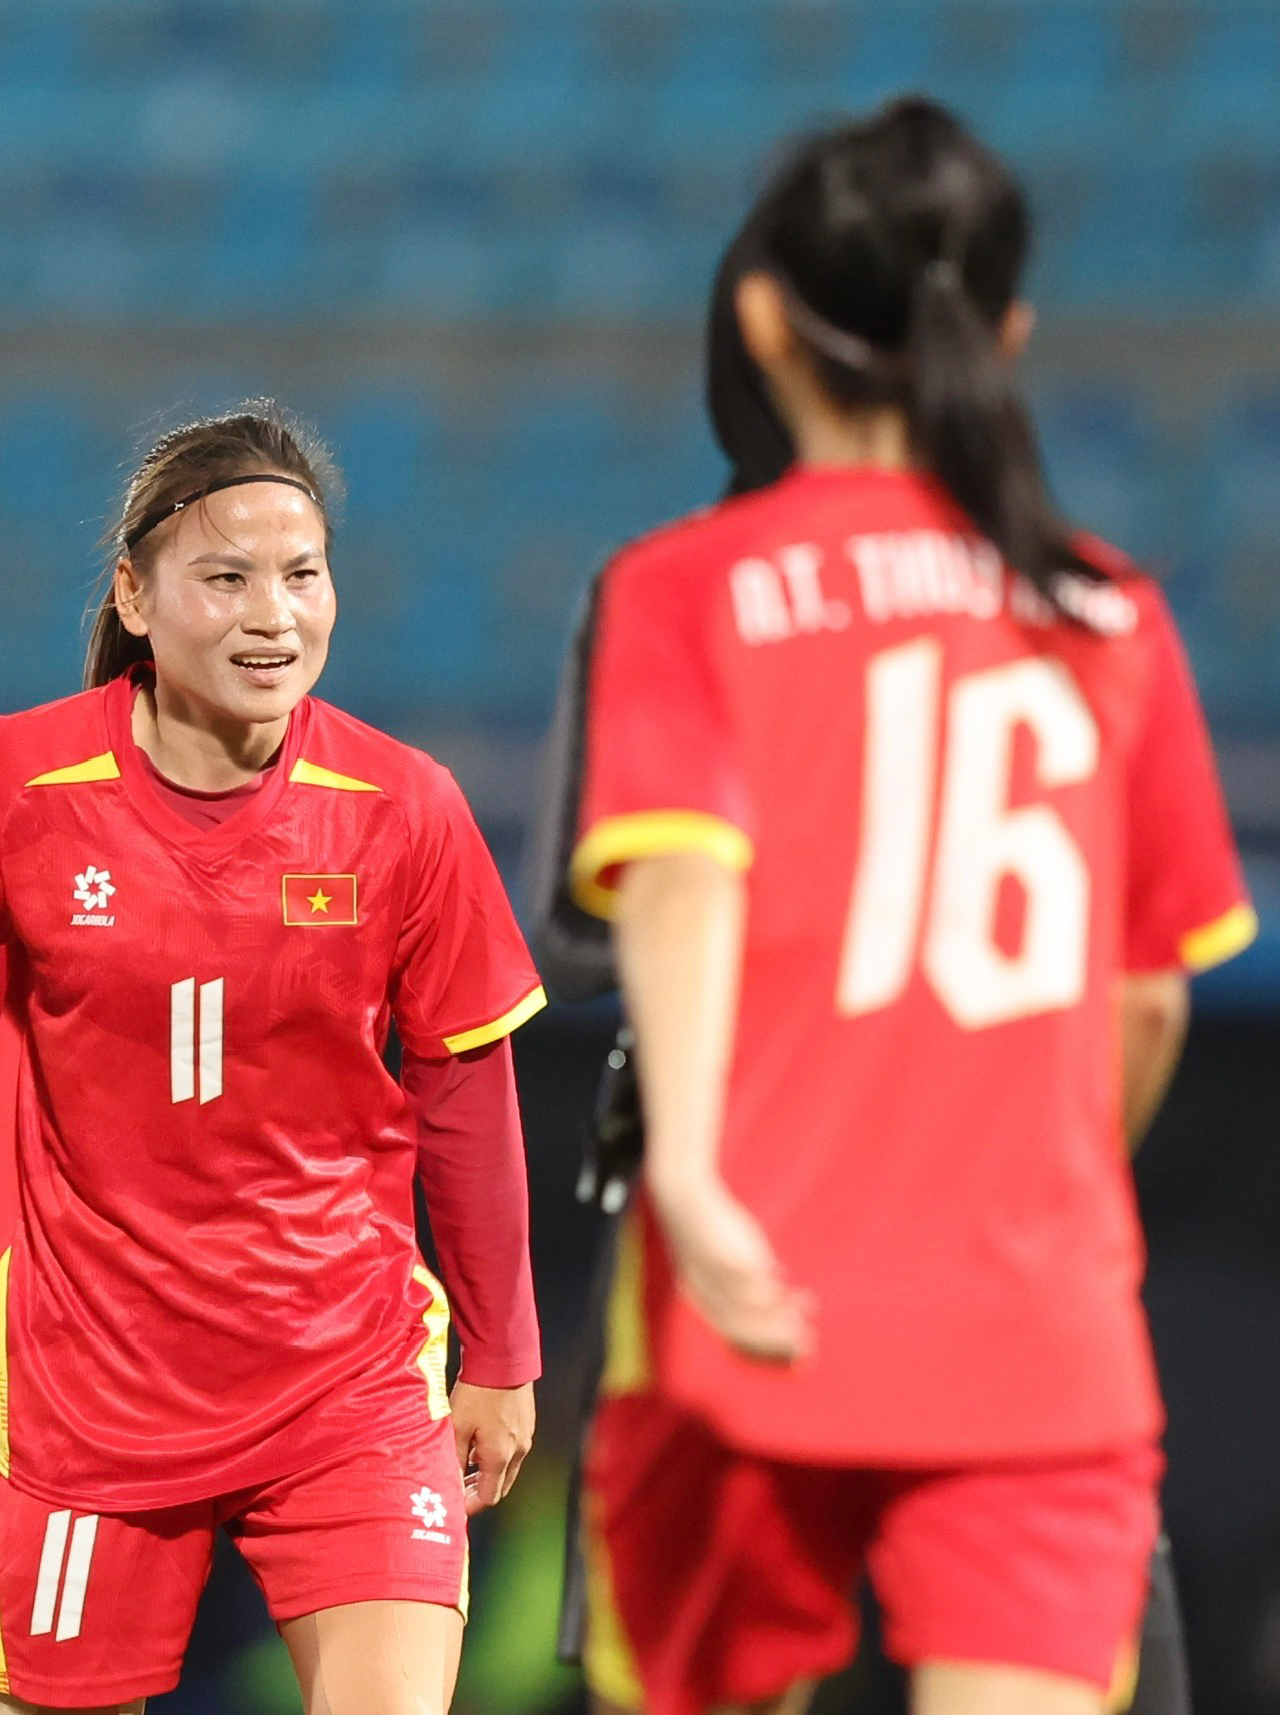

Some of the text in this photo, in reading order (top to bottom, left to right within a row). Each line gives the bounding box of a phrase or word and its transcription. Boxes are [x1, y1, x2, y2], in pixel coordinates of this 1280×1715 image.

[835, 635, 1099, 1031] 16
[171, 976, 224, 1106] 11
[29, 1508, 99, 1642] 11
